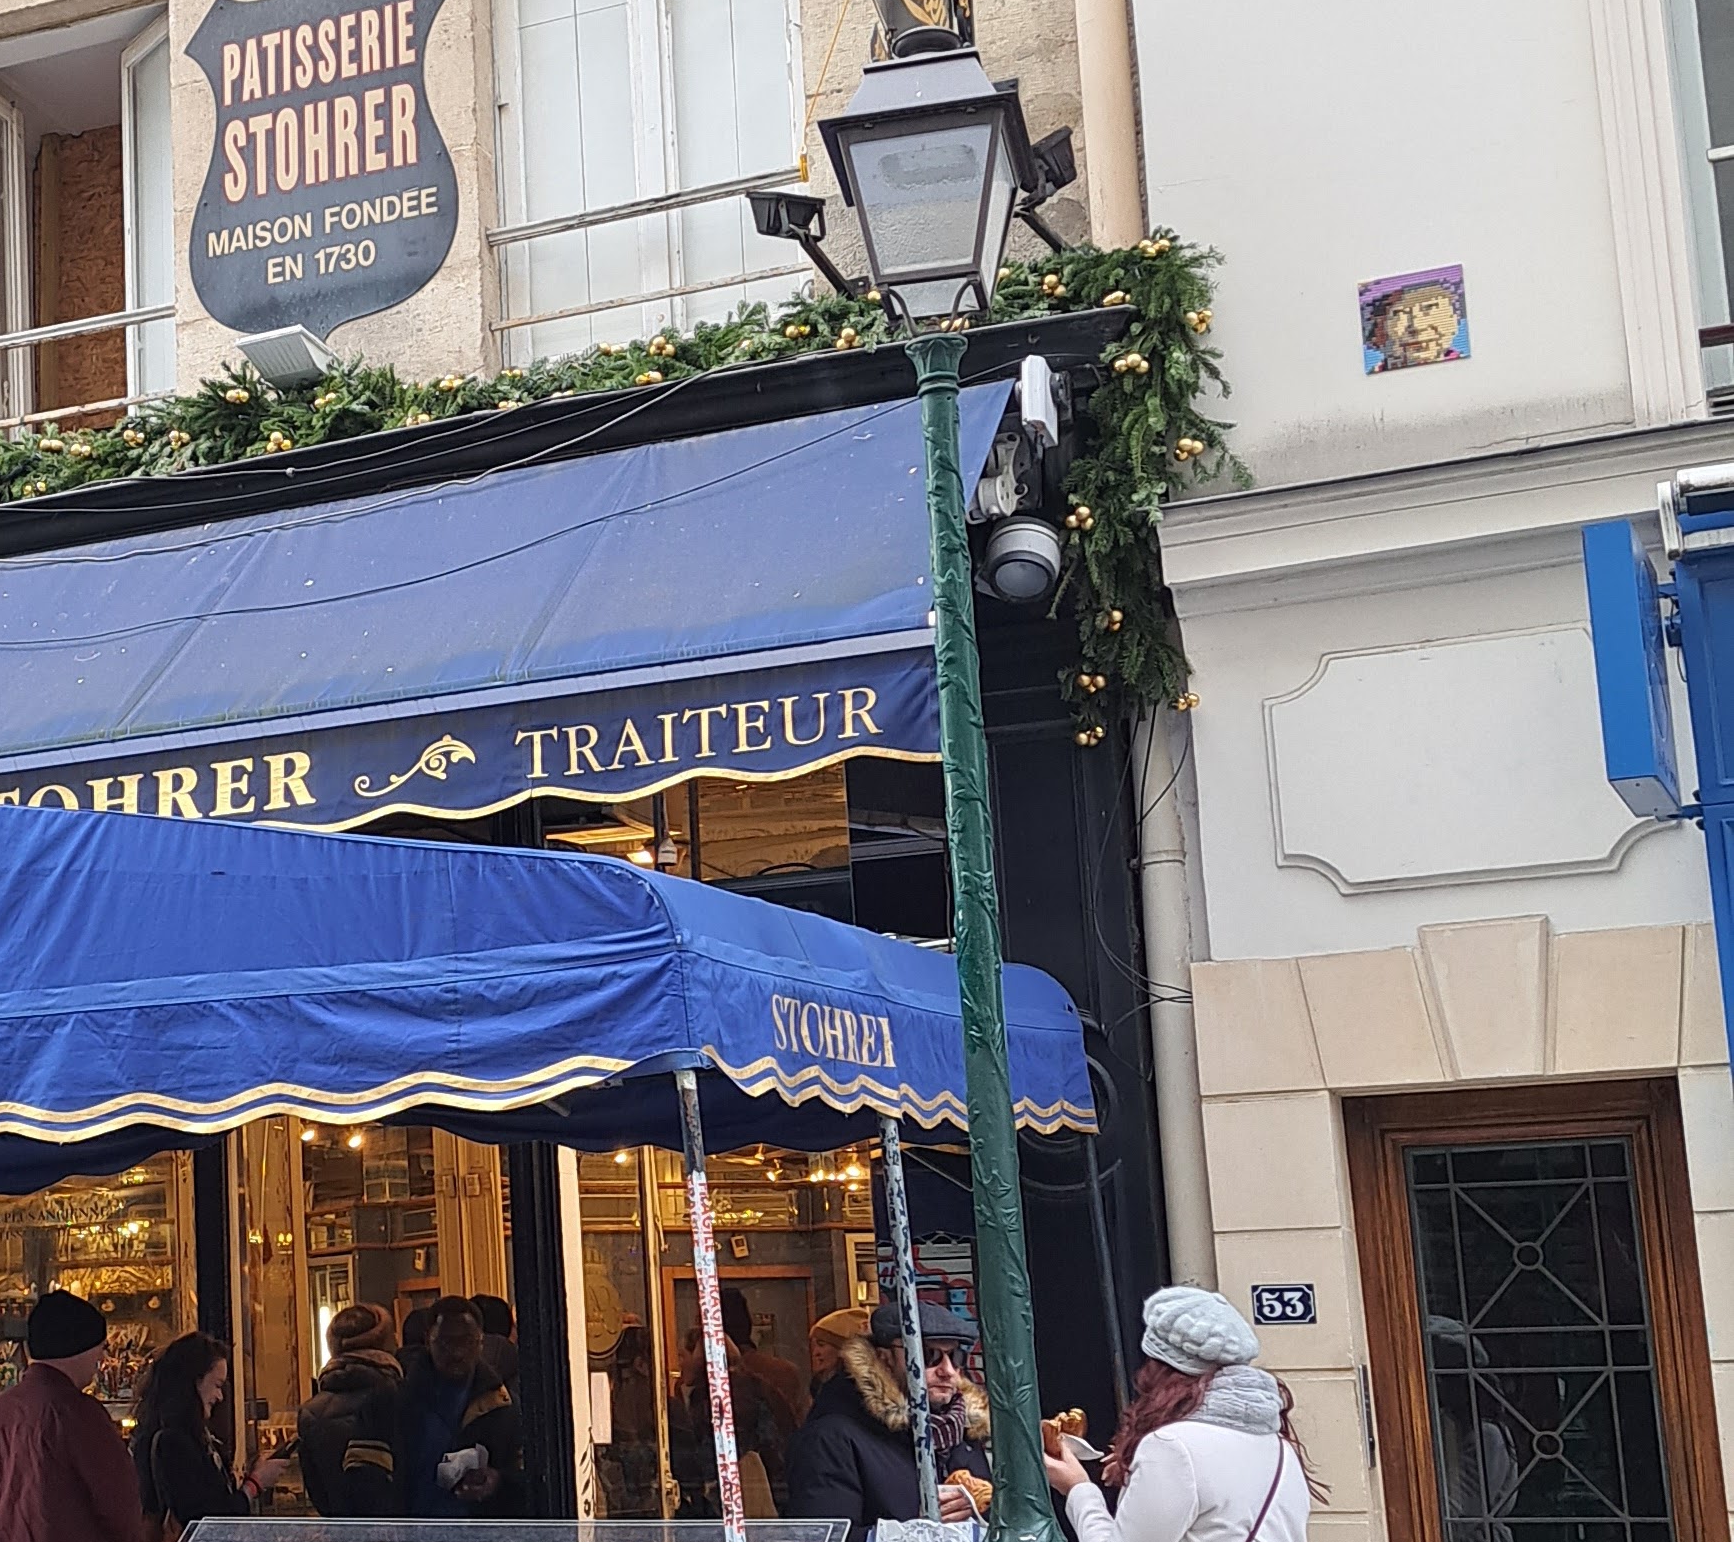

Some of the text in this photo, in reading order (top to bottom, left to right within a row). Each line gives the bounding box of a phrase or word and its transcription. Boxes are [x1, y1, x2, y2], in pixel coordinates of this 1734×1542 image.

[223, 0, 416, 107] PATISSERIE
[223, 82, 418, 203] STOHRER
[207, 185, 439, 258] MAISON FONDÉE
[267, 239, 377, 285] EN 1730
[514, 686, 884, 779] TRAITEUR
[1261, 1291, 1305, 1318] 53
